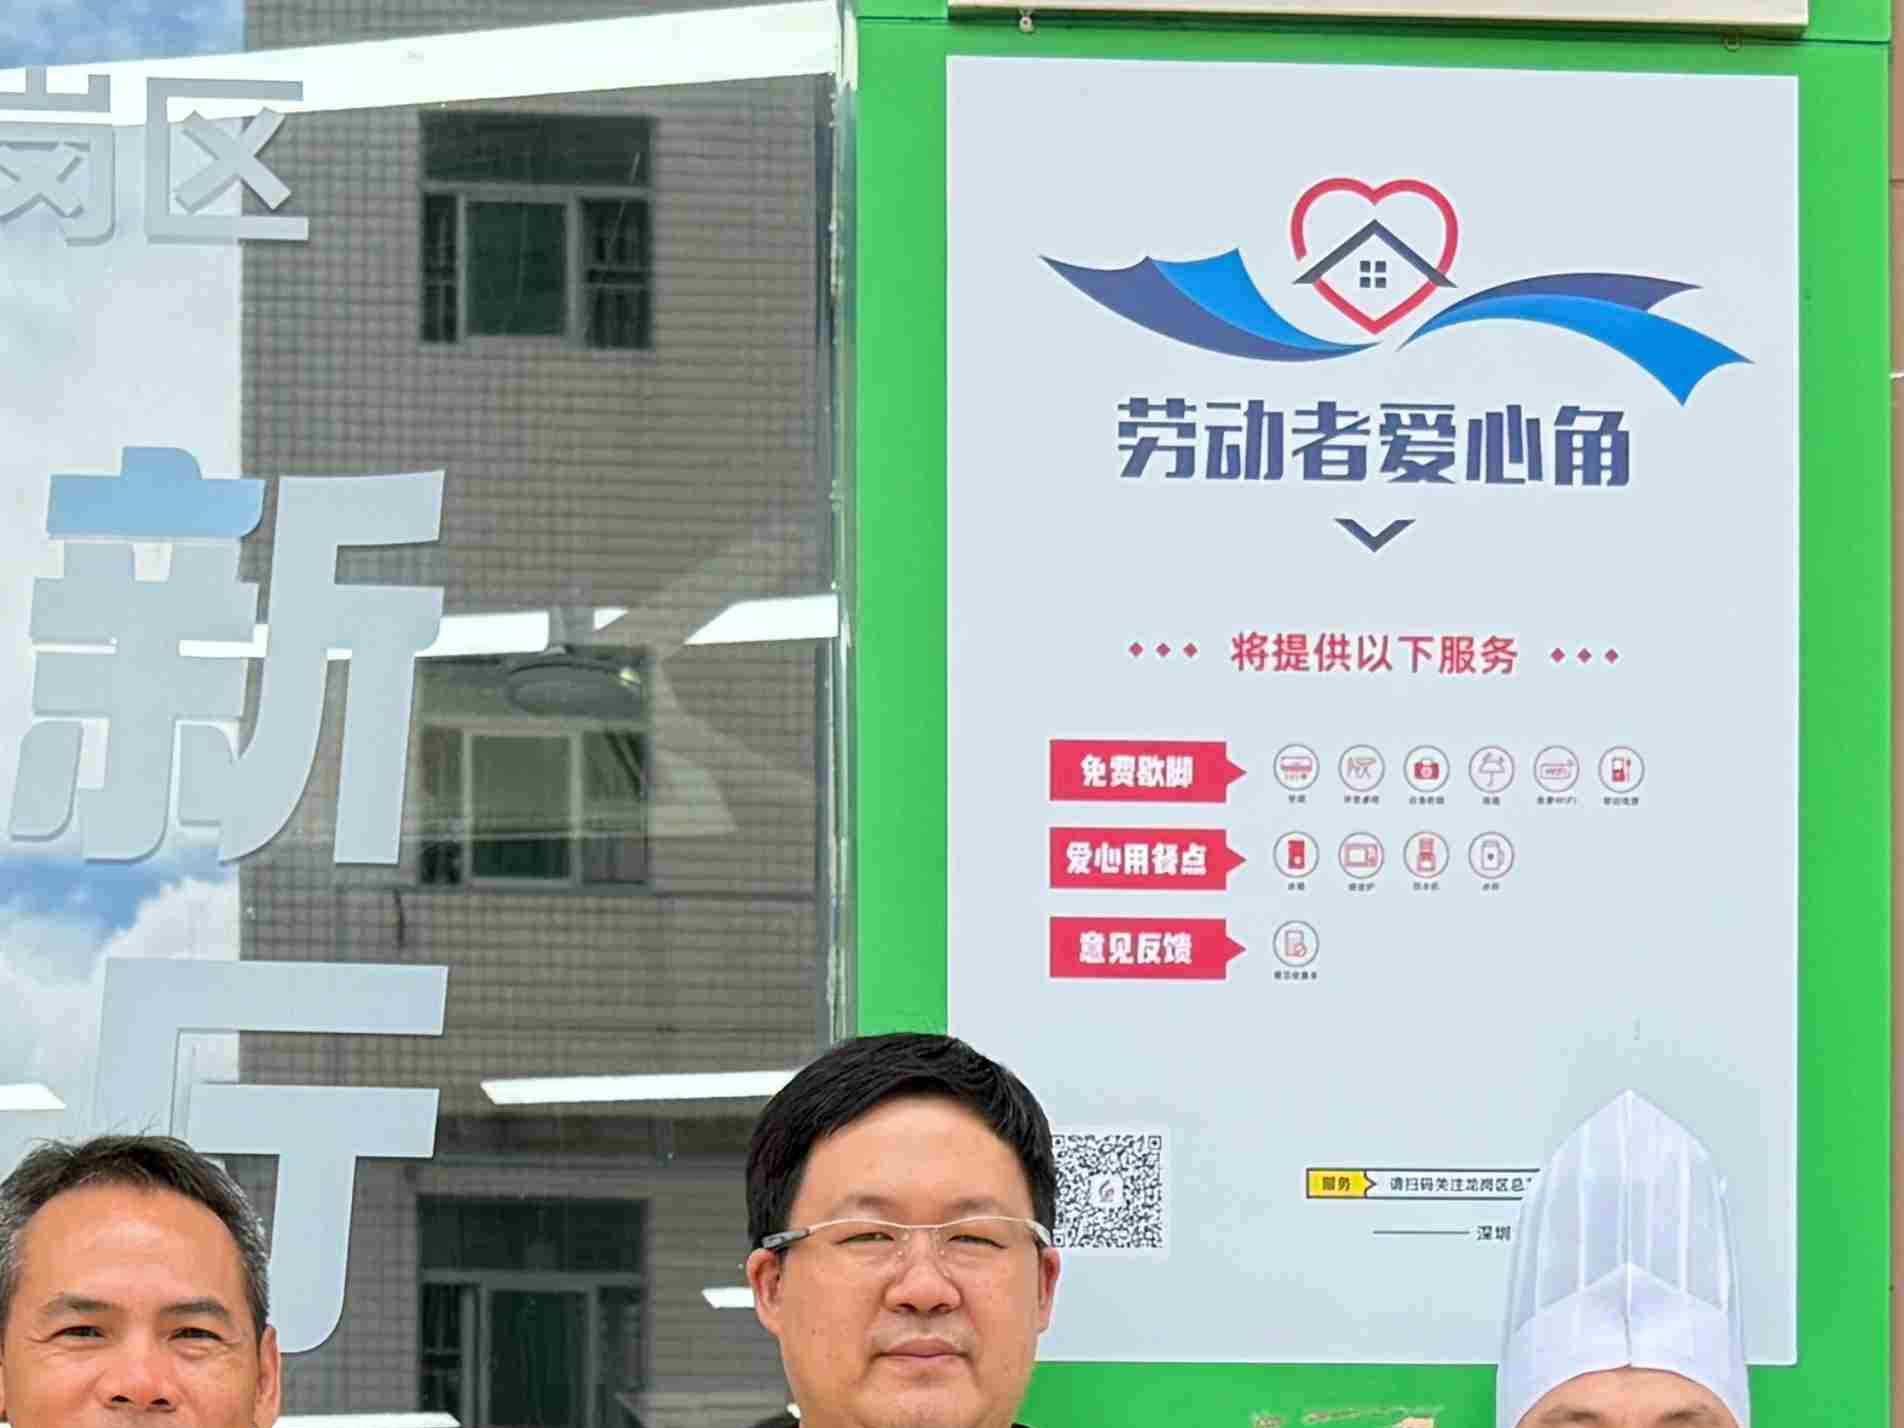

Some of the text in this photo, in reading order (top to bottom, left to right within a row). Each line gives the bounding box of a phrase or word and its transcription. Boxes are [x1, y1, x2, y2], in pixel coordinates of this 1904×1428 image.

[1118, 397, 1632, 487] 劳动者爱心角
[1230, 631, 1519, 677] 将提供以下服务
[1080, 754, 1193, 788] 免费歇脚
[1066, 841, 1207, 876] 爱心用餐点
[1079, 931, 1192, 965] 意见反馈
[1389, 1176, 1533, 1193] 请扫码关注龙岗区总
[1476, 1225, 1512, 1241] 深圳
